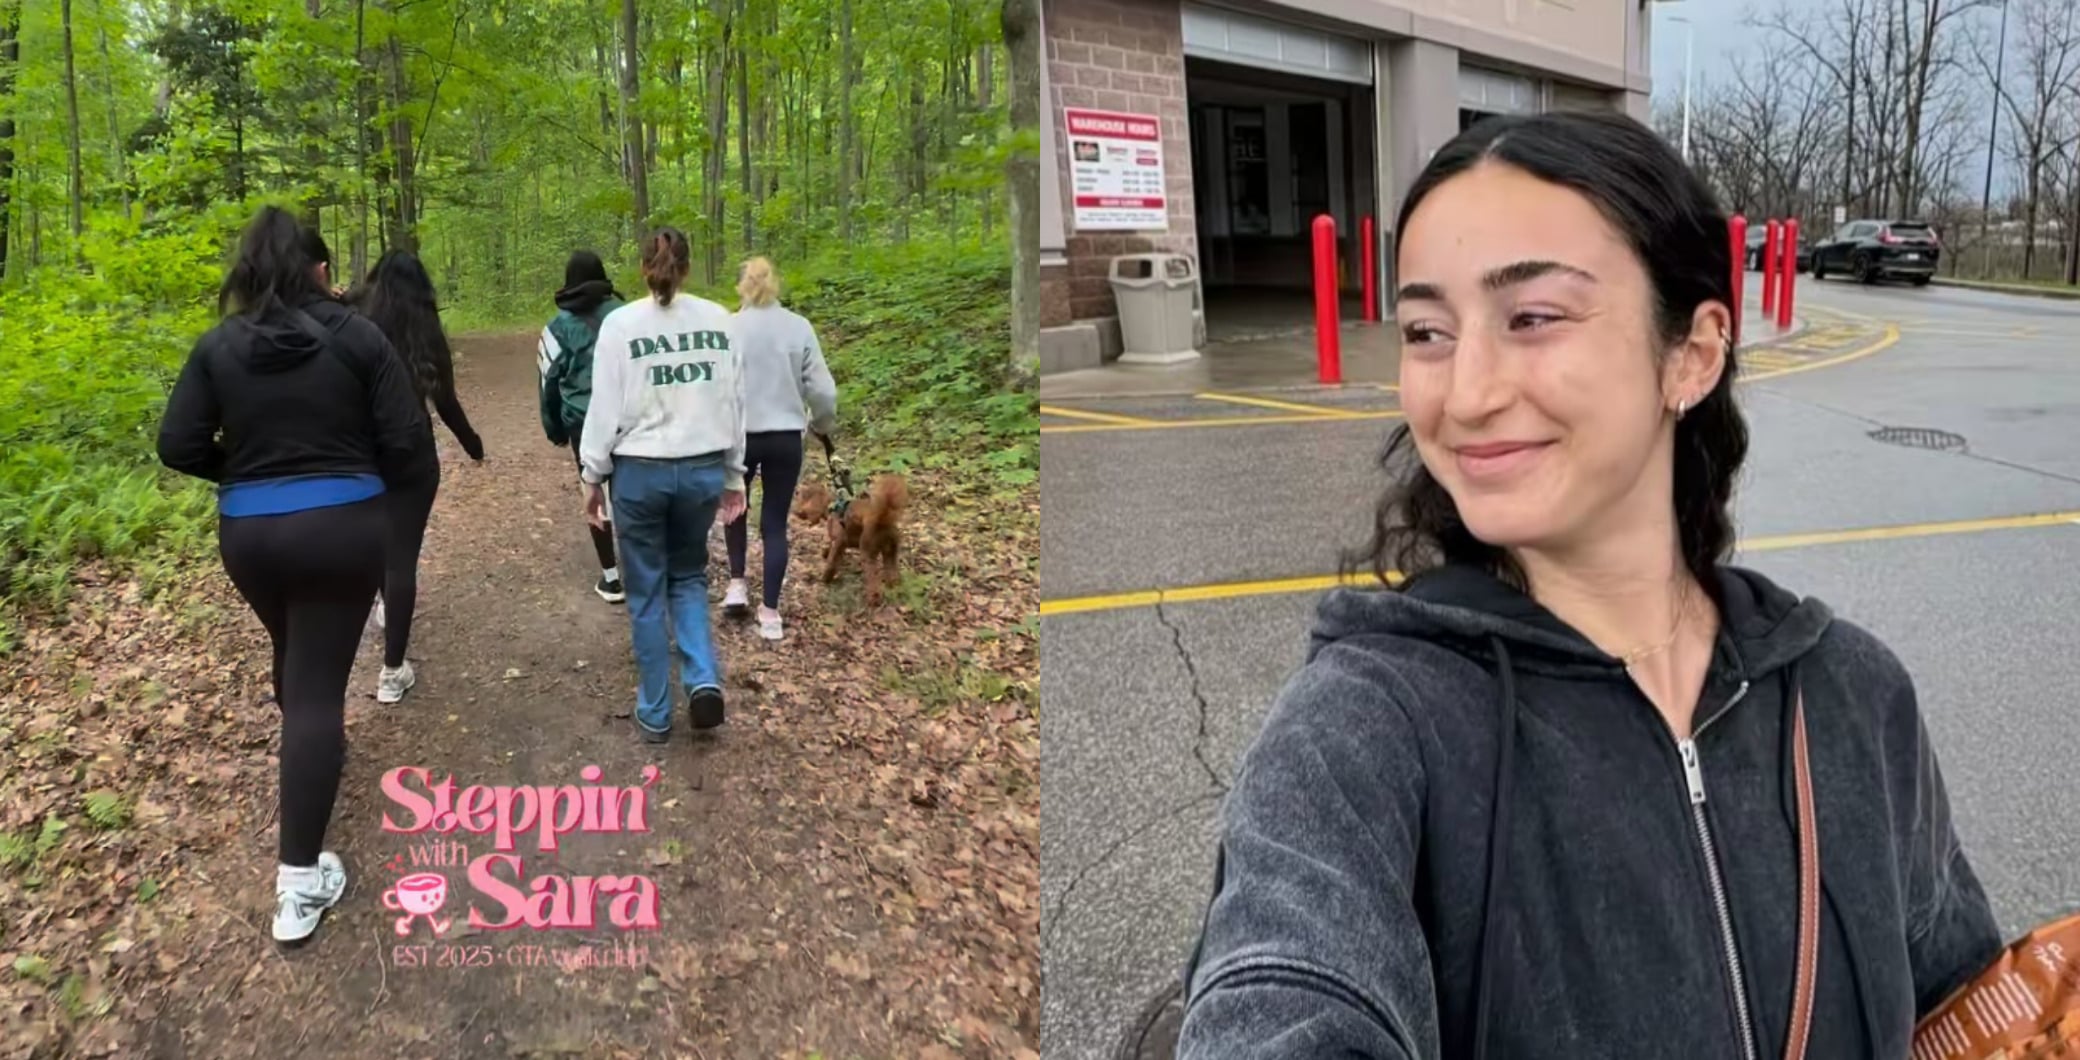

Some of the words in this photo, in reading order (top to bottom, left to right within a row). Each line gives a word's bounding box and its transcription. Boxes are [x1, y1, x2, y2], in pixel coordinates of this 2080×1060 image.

[1070, 117, 1126, 134] WAREHOUSE
[627, 330, 730, 359] DAIRY
[649, 361, 715, 386] BOY
